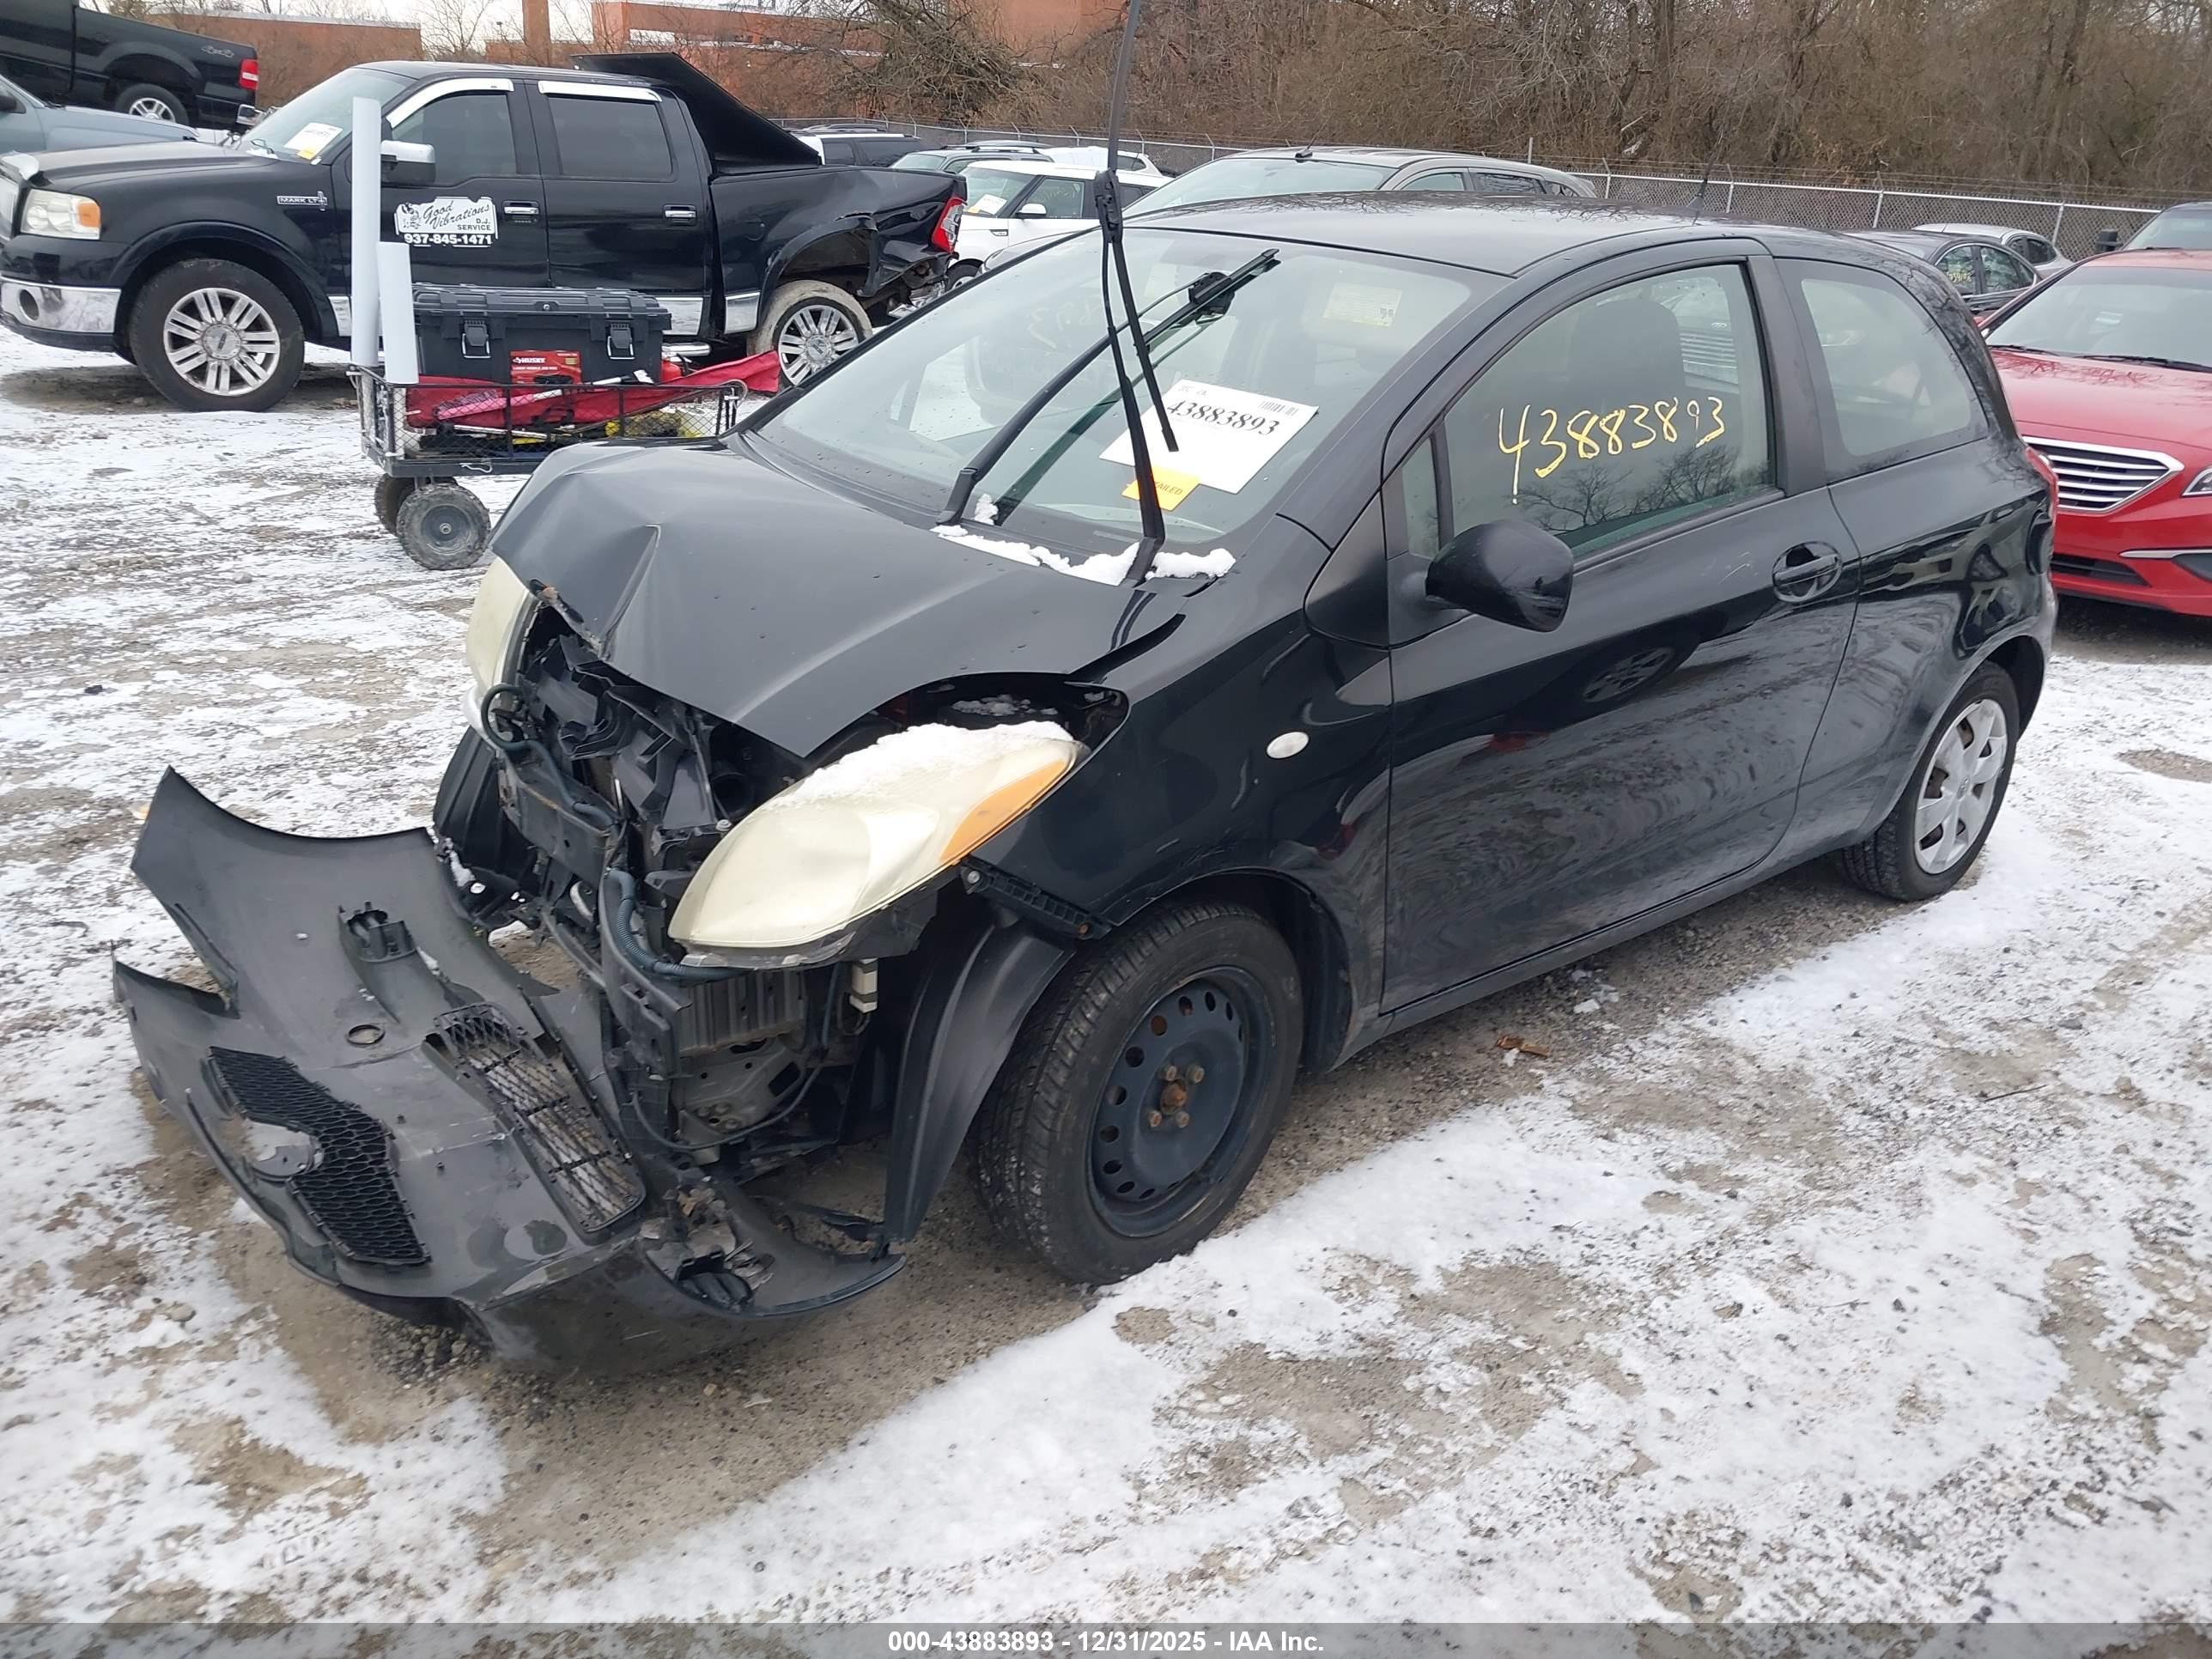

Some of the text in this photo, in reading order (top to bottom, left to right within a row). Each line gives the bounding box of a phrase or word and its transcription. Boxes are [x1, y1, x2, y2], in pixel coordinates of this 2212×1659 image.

[422, 200, 454, 224] Good
[429, 204, 489, 229] Vibrations
[404, 233, 492, 245] 937-845-1471
[1167, 399, 1280, 435] 43883893
[1498, 397, 1725, 505] 43883893
